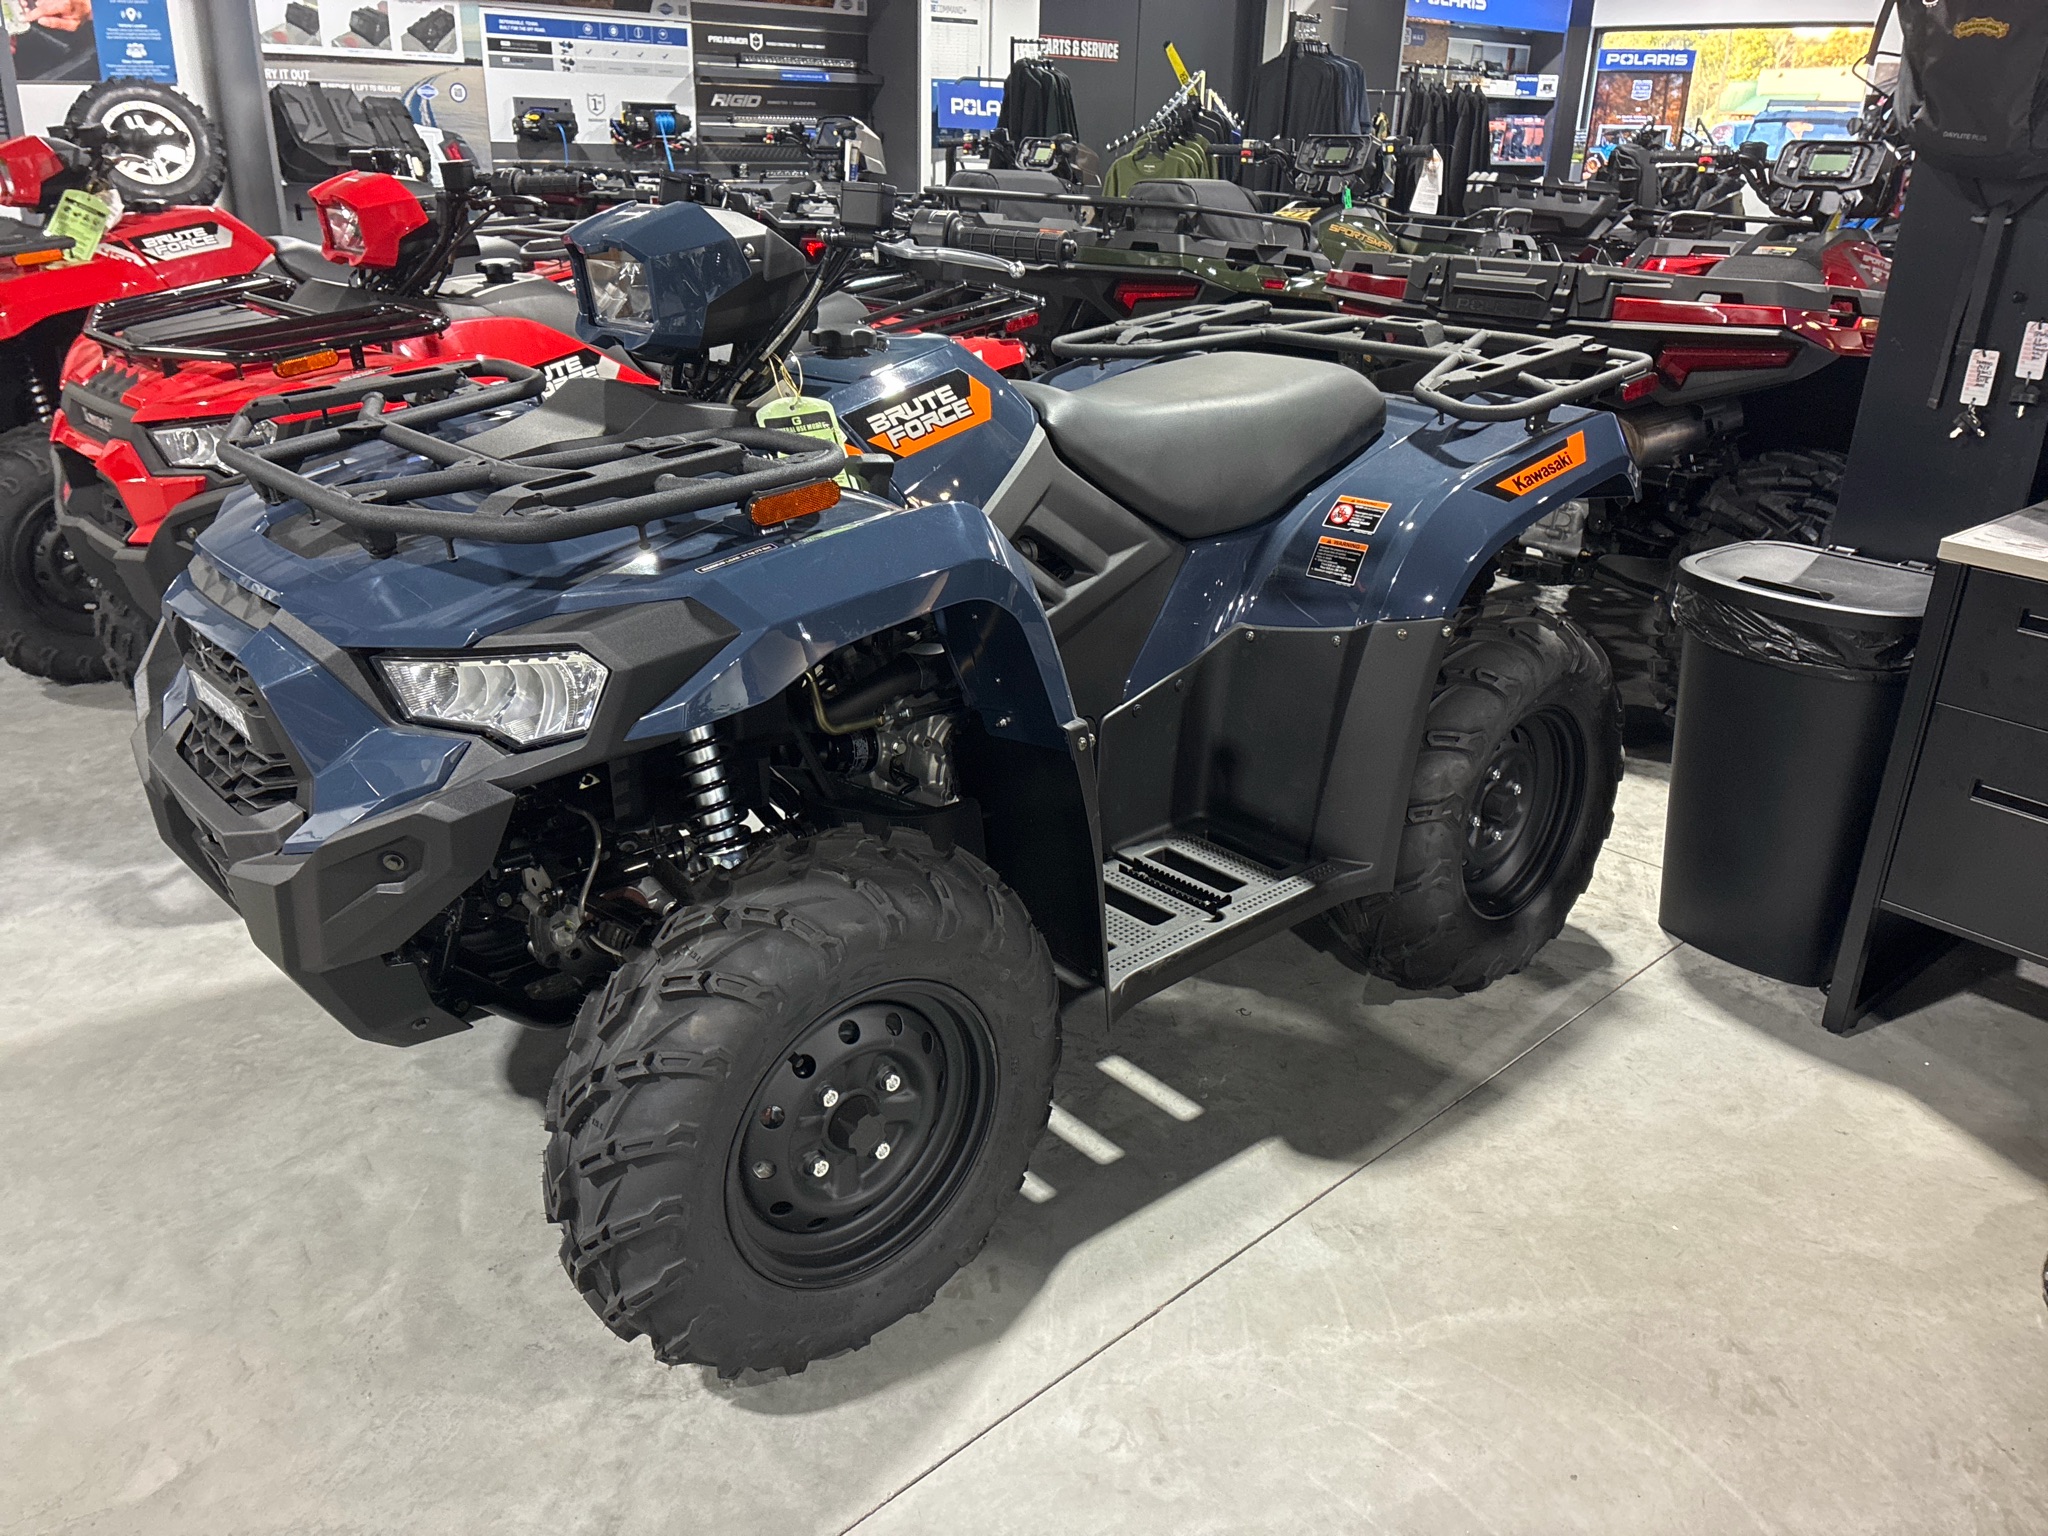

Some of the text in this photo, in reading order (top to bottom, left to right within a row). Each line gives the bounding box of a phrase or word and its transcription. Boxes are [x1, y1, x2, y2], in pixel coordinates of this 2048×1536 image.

[1072, 41, 1080, 56] &
[1080, 41, 1120, 59] SERVICE
[1605, 53, 1688, 66] POLARIS
[264, 68, 311, 81] RY IT OUT
[710, 93, 763, 108] RIGID
[950, 97, 1002, 117] POLA
[1942, 130, 1988, 142] DAYLITE PLUS
[141, 227, 209, 249] BRUTE
[155, 235, 220, 257] FORCE
[1328, 223, 1395, 253] SPORTSMAN
[1862, 254, 1892, 270] SPORTS
[866, 384, 958, 434] BRUTE
[791, 416, 802, 426] G
[796, 425, 807, 433] USE
[885, 397, 974, 449] FORCE
[1511, 450, 1573, 492] Kawasaki
[1333, 540, 1361, 549] WARNING
